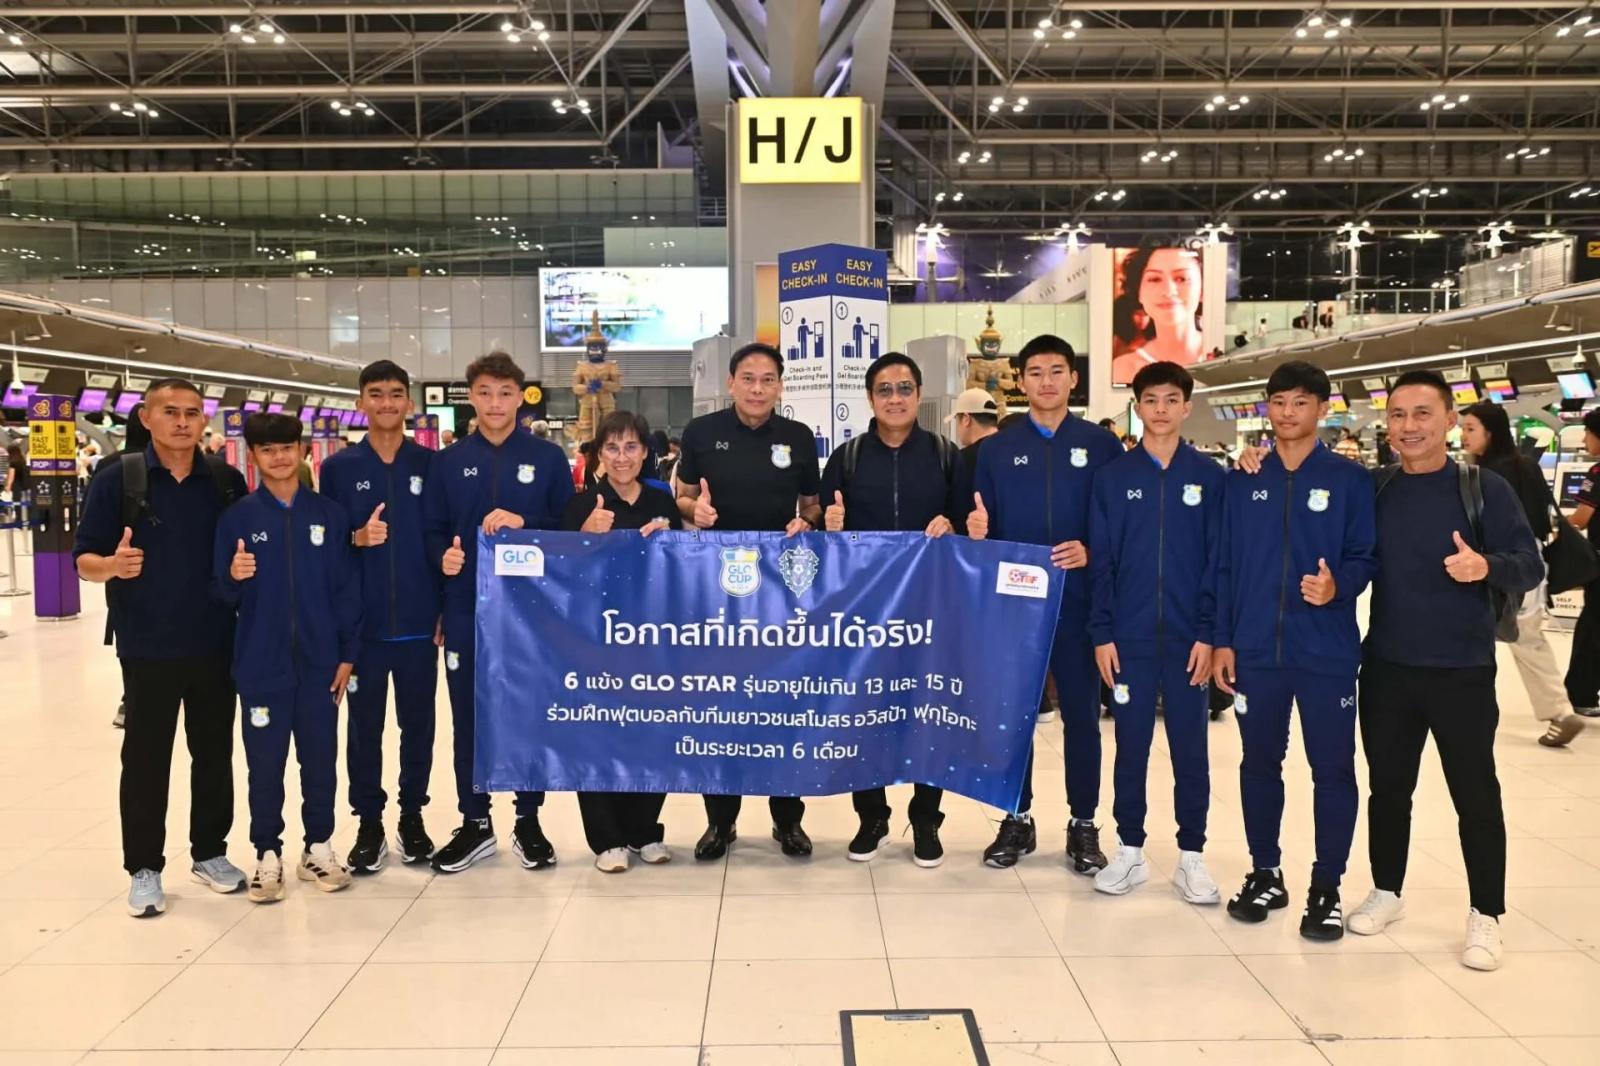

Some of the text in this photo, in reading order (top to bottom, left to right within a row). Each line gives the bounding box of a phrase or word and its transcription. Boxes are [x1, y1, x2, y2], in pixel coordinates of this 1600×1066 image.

[792, 259, 817, 273] EASY
[846, 258, 873, 272] EASY
[781, 273, 828, 291] CHECK-IN
[835, 273, 884, 289] CHECK-IN
[502, 550, 537, 563] GLO
[728, 575, 752, 584] CUP
[602, 607, 933, 648] โอกาสที่เกิดขึ้นได้จริง!
[564, 672, 963, 700] 6 แข้ง GLO STAR รุ่นอายุไม่เกิน 13 และ 15 ปี
[913, 703, 977, 731] ฟุกุโอกะ
[675, 736, 859, 760] เป็นระยะเวลา 6 เดือน
